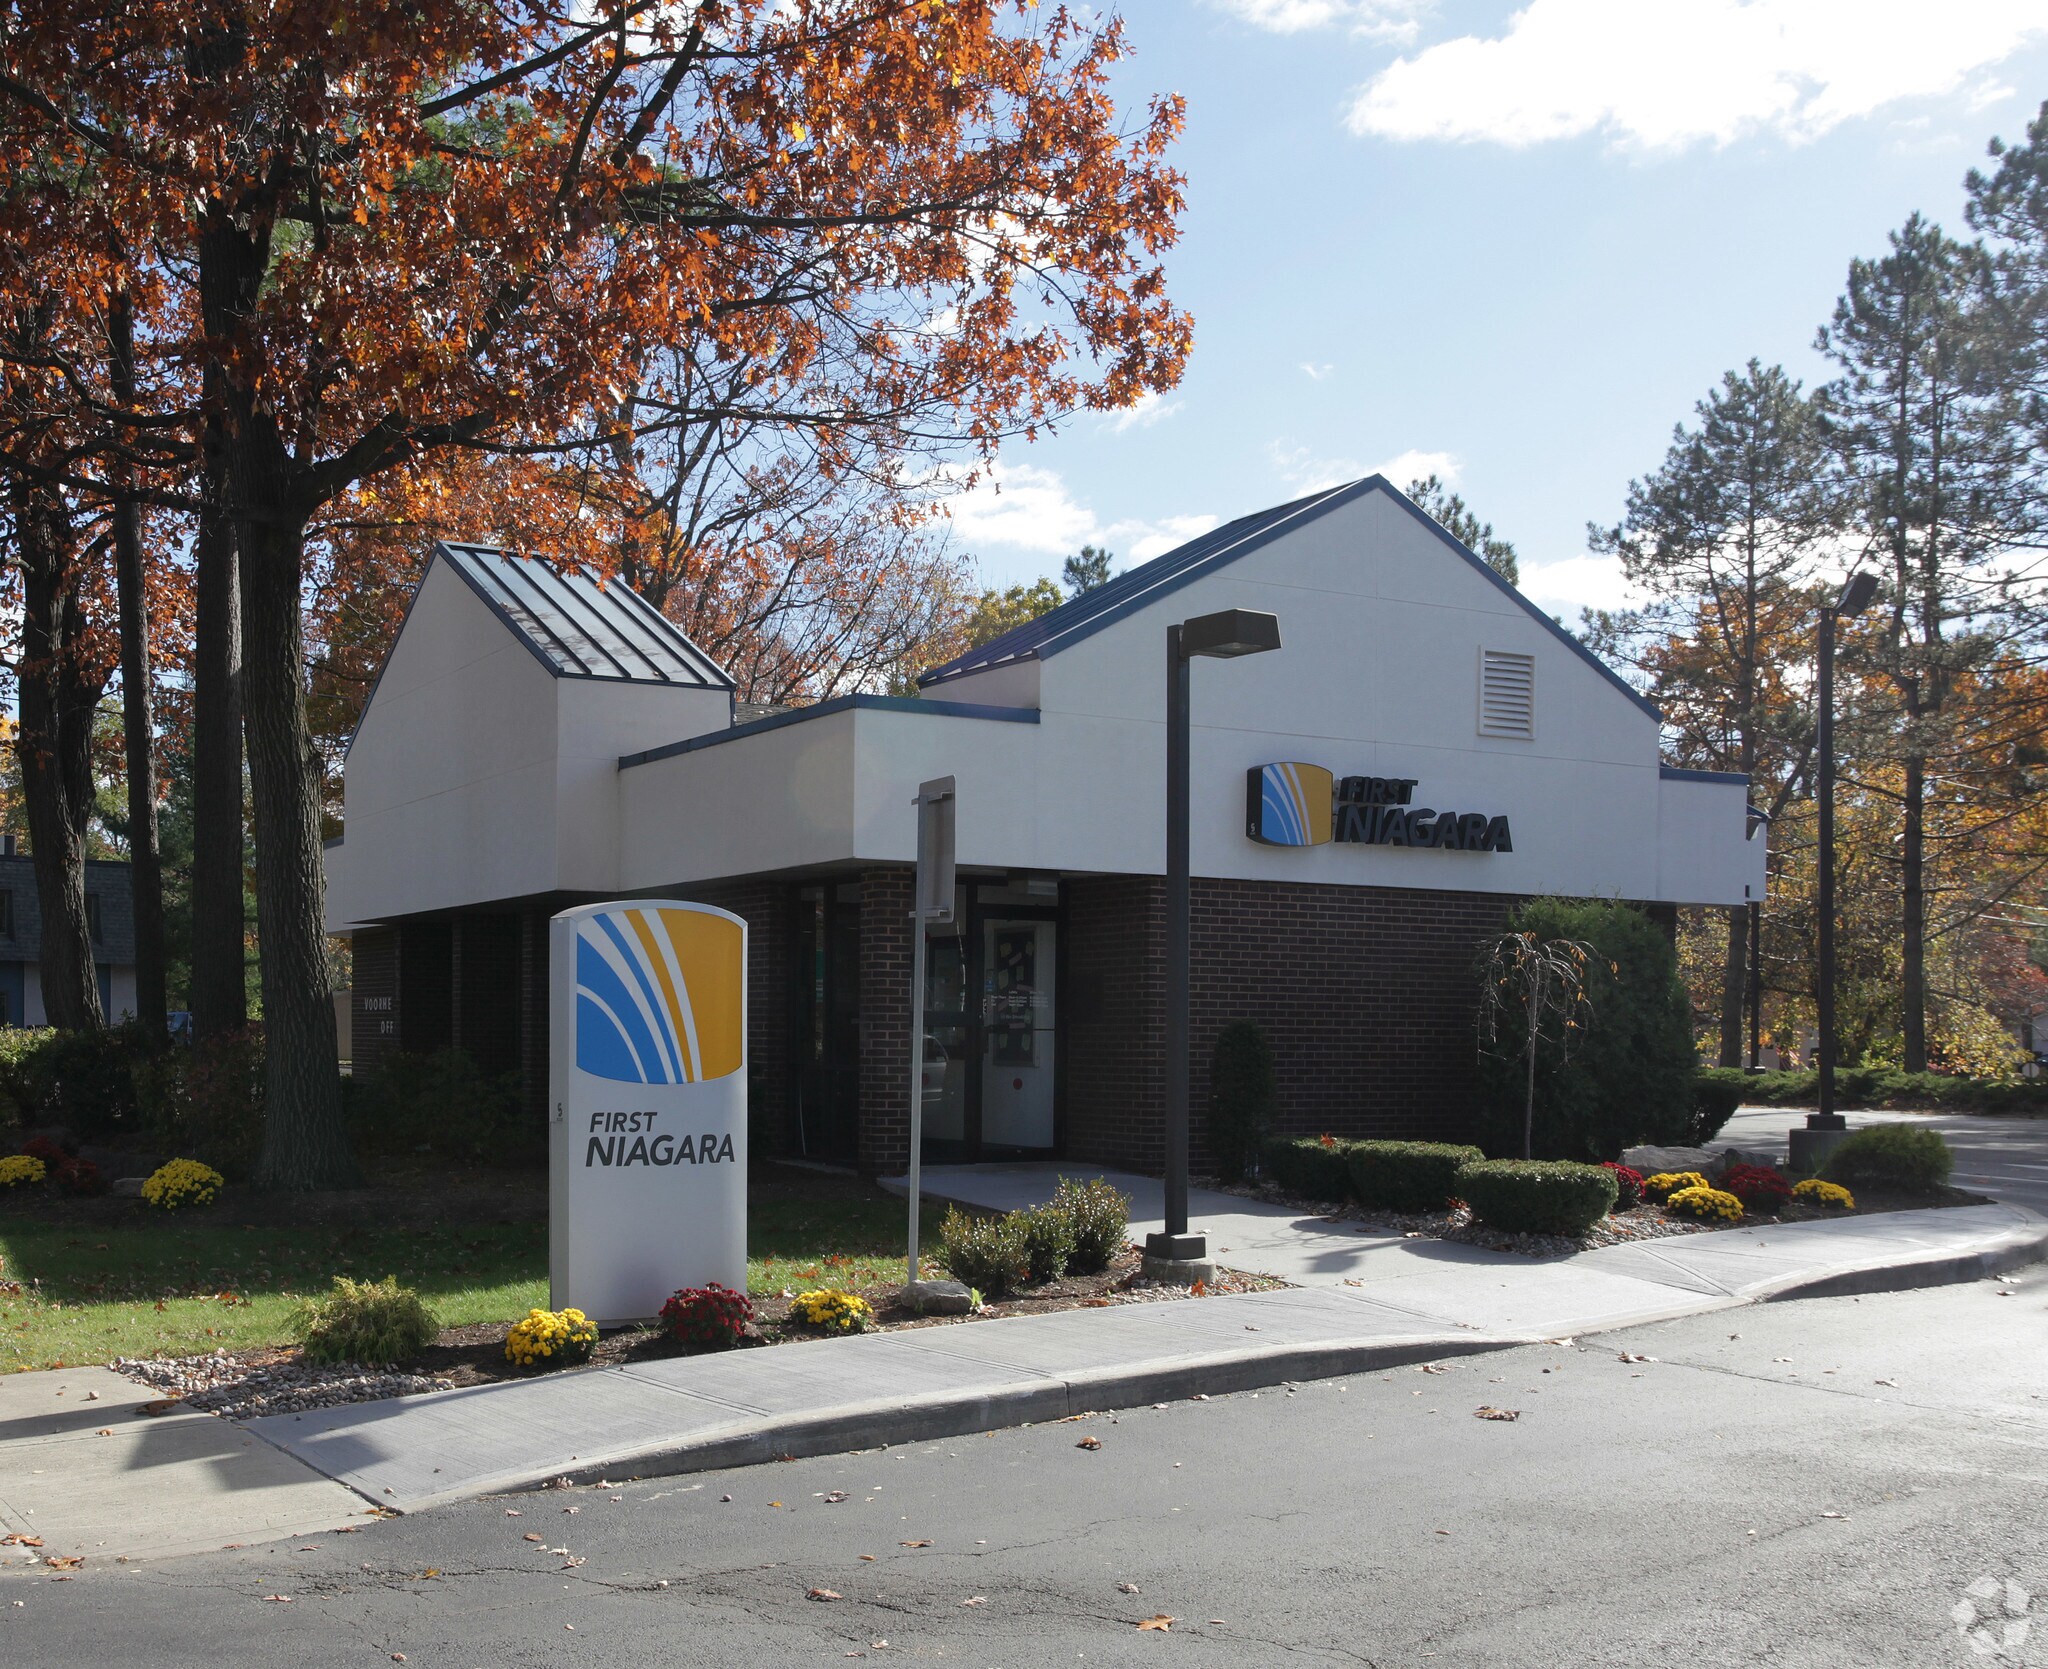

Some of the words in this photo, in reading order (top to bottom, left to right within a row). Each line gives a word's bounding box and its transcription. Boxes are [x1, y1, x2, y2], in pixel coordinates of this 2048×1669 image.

[1339, 776, 1418, 805] FIRST
[1335, 804, 1513, 853] NIAGARA
[589, 1111, 658, 1133] FIRST
[585, 1133, 735, 1168] NIAGARA
